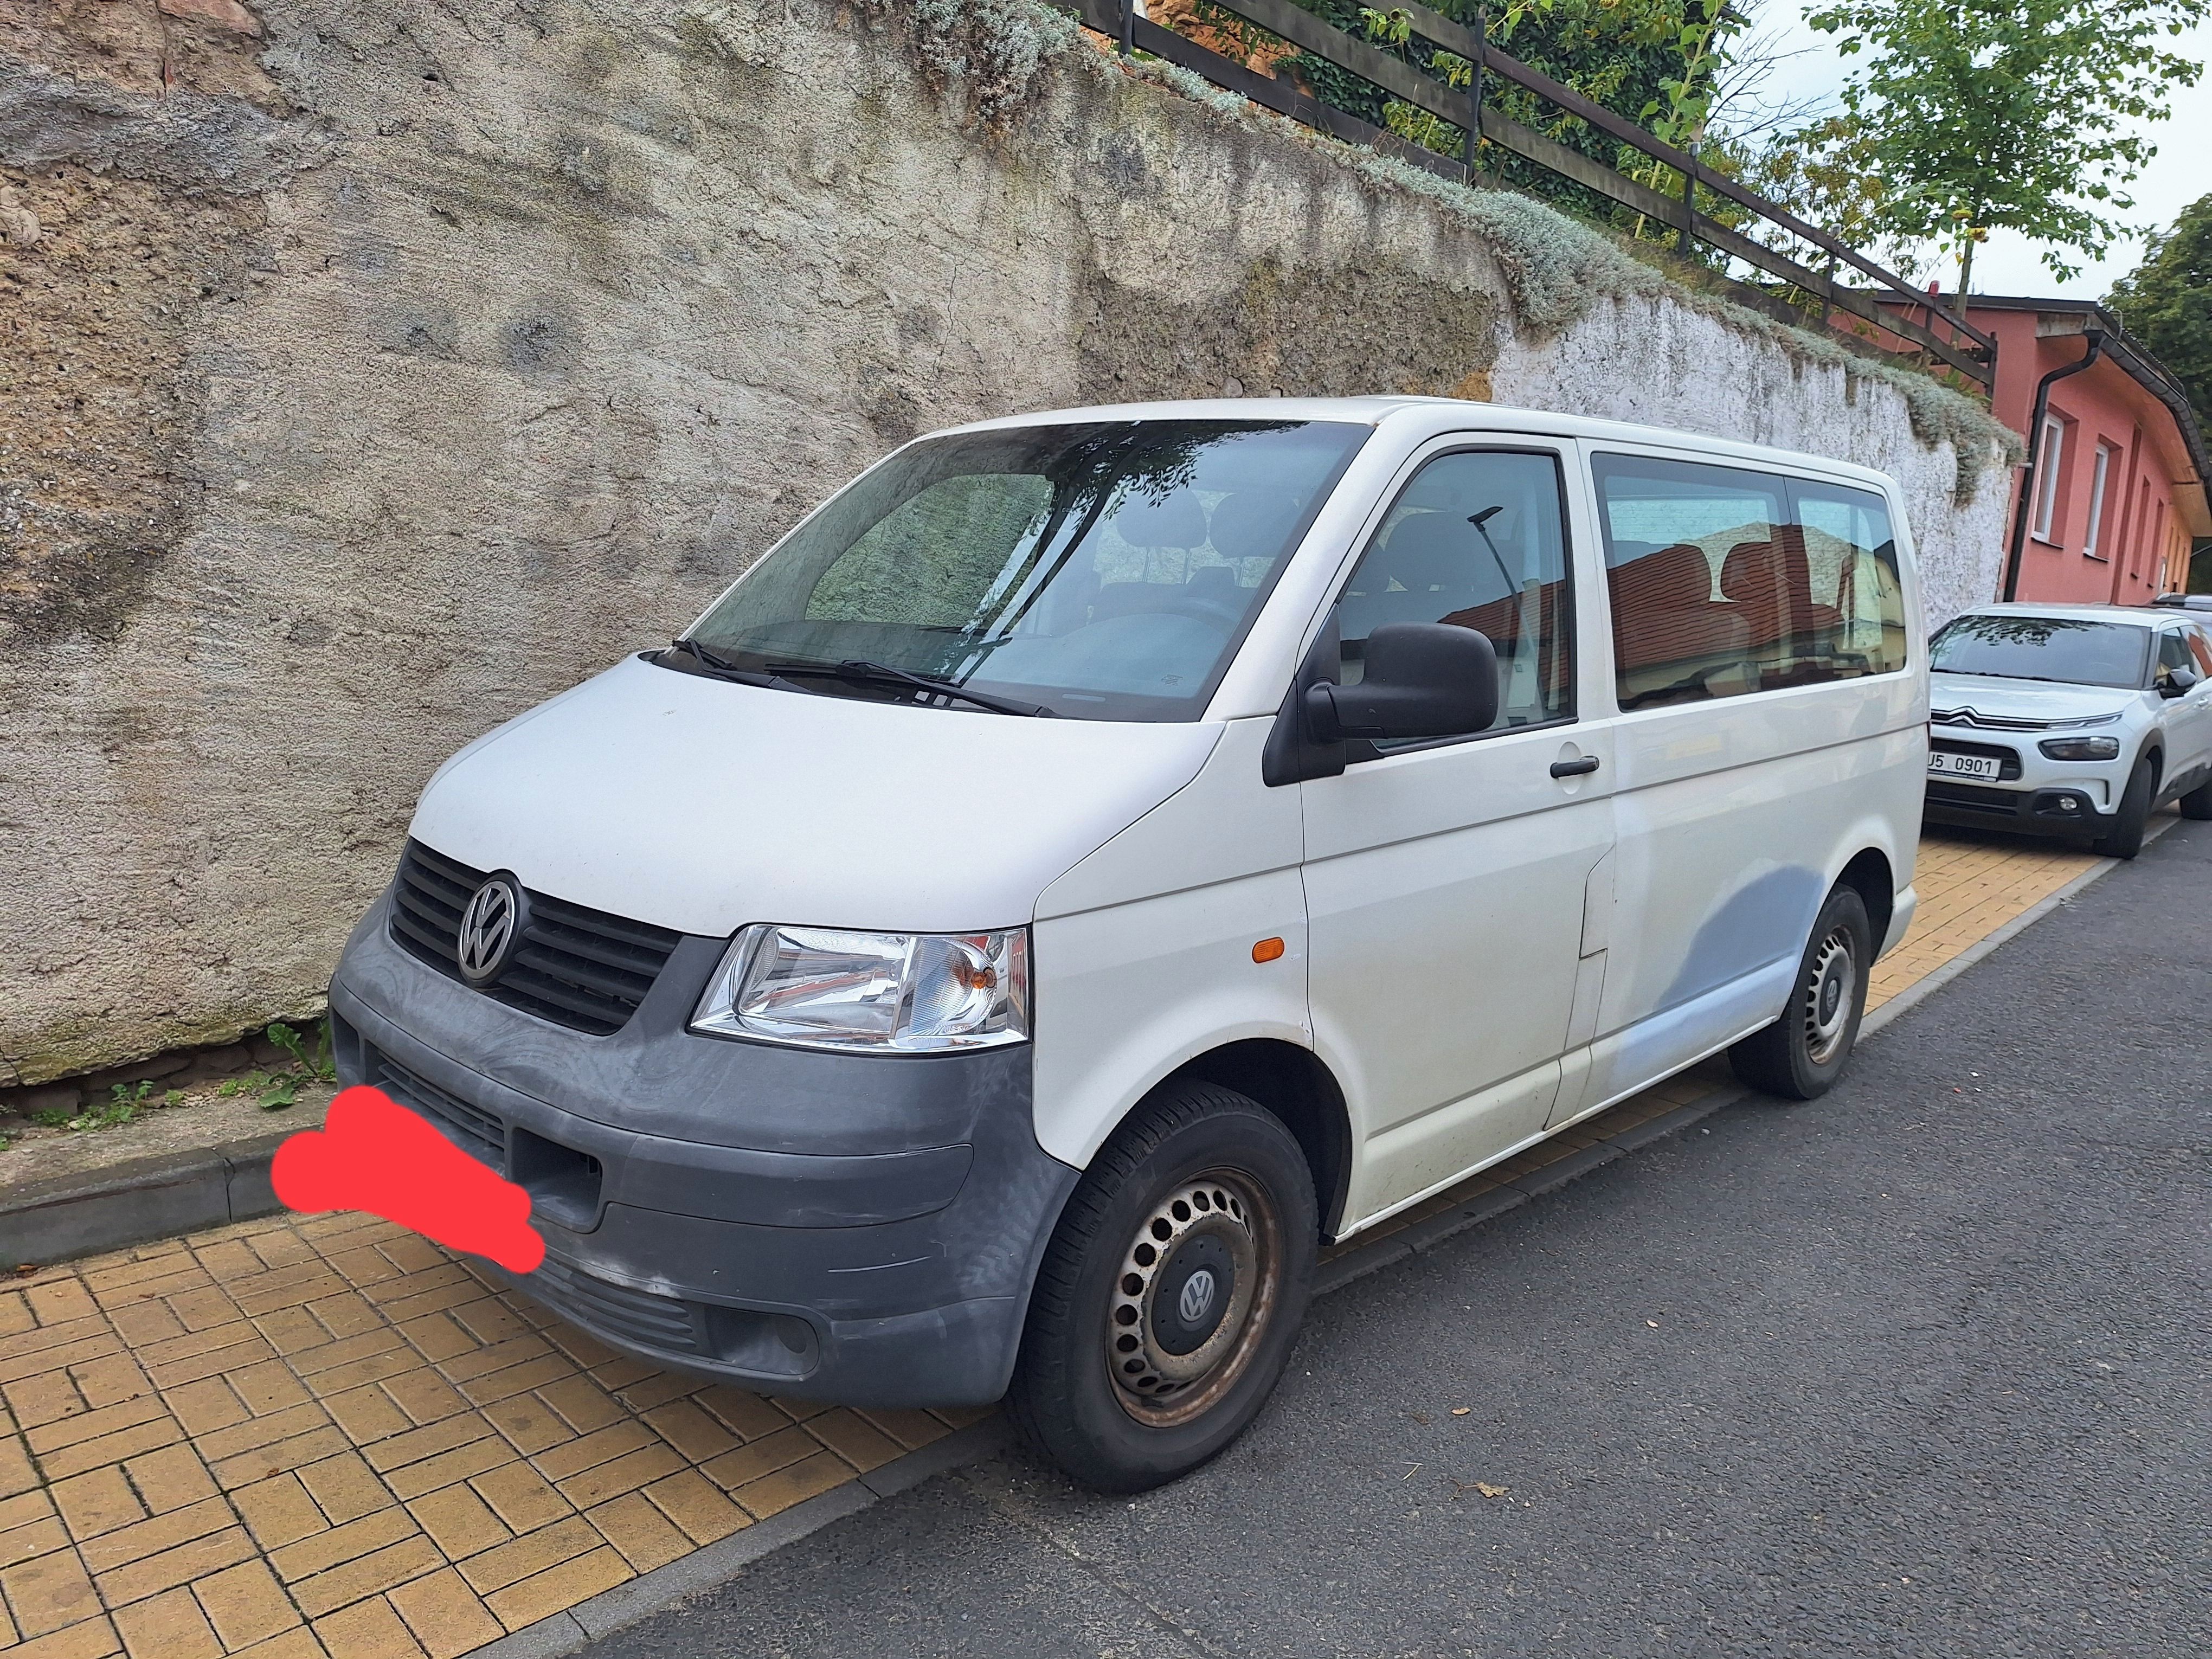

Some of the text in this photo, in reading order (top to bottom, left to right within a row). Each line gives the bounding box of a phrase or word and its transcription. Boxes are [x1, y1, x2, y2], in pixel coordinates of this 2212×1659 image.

[1955, 757, 1992, 774] 0901
[460, 882, 515, 979] VW
[1180, 1271, 1214, 1321] VW
